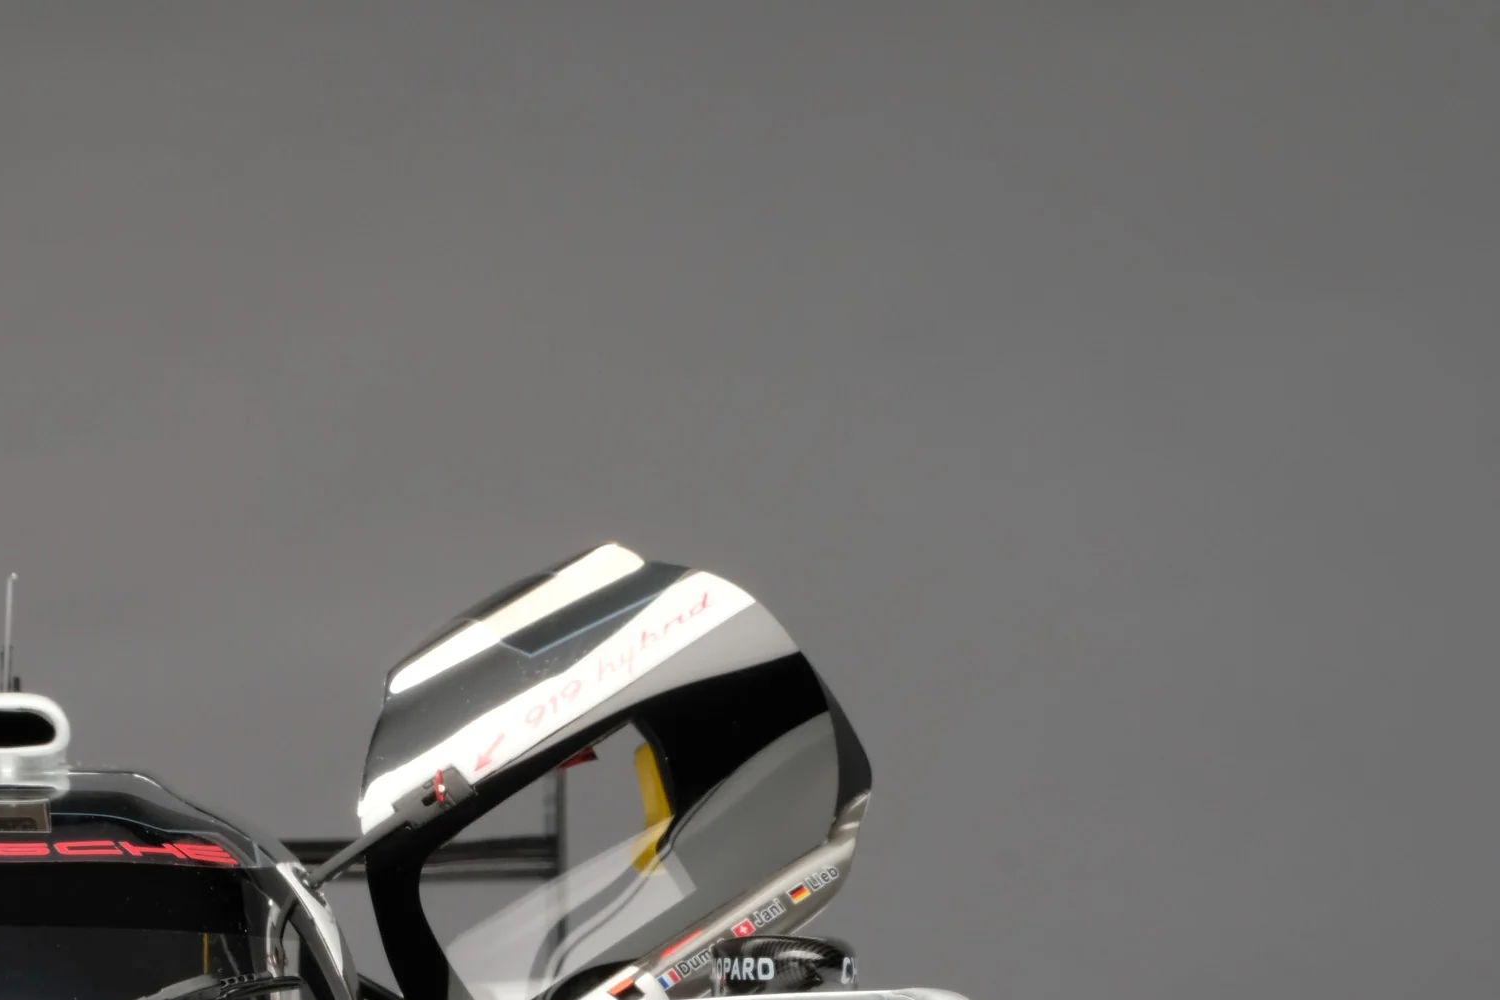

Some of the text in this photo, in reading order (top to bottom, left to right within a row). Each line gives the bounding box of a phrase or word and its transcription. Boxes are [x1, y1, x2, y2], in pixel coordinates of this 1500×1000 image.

[524, 680, 582, 728] 919
[754, 898, 785, 928] Jani
[808, 866, 839, 891] Lieb
[711, 957, 775, 981] OPARD
